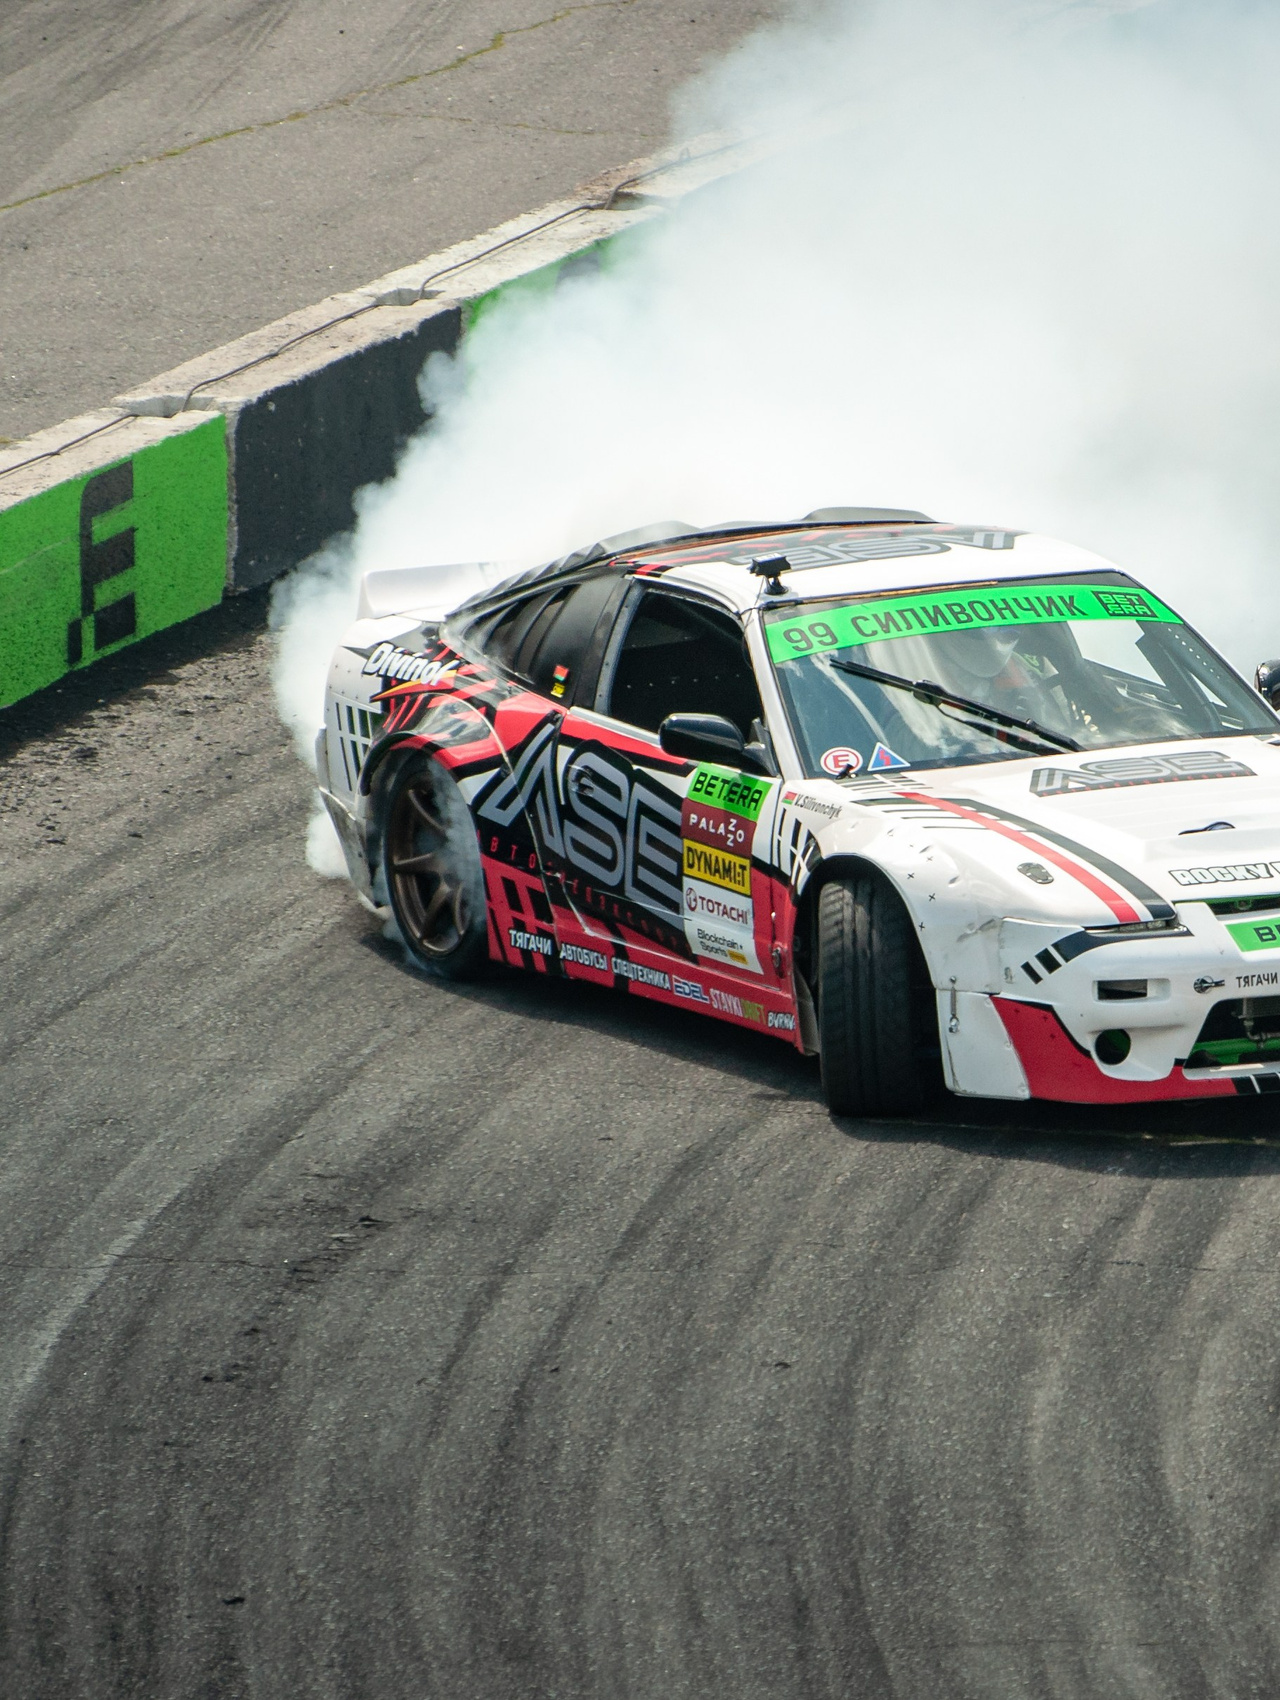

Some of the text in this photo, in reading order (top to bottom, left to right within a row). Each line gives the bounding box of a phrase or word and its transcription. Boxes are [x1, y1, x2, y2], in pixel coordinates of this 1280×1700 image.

[782, 595, 1089, 652] 99 СИЛИВОНЧИК
[689, 817, 745, 847] PALAZZO
[1168, 863, 1273, 886] ROCKY
[698, 895, 748, 925] TOTACHI
[508, 929, 672, 991] ТЯГАЧИ АВТОБУСЫ СПЕЦТЕХНИКА
[1236, 972, 1278, 989] ТЯГАЧИ
